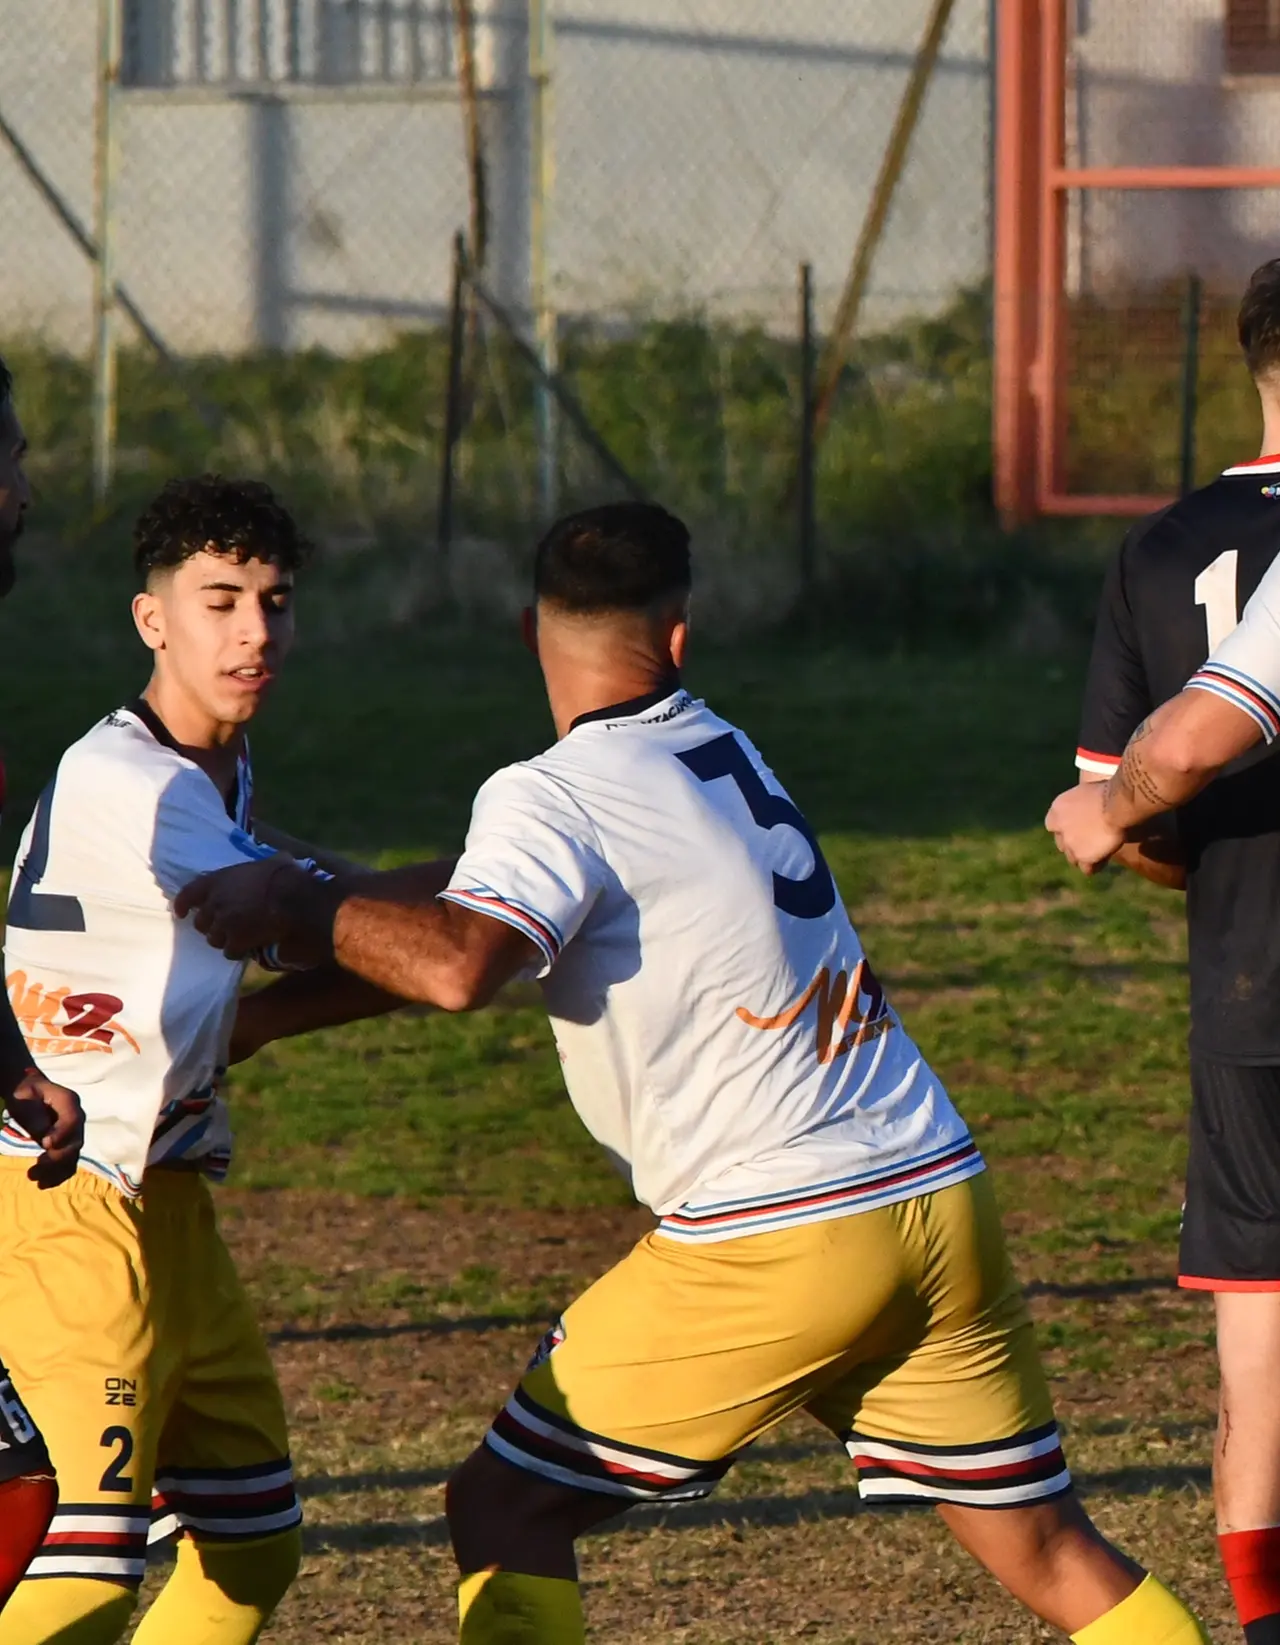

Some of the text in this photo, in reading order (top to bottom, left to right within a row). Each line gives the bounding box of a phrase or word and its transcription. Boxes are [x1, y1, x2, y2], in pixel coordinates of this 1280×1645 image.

[673, 731, 836, 919] 3
[105, 1377, 137, 1391] ON
[105, 1393, 137, 1406] ZE
[98, 1425, 133, 1493] 2
